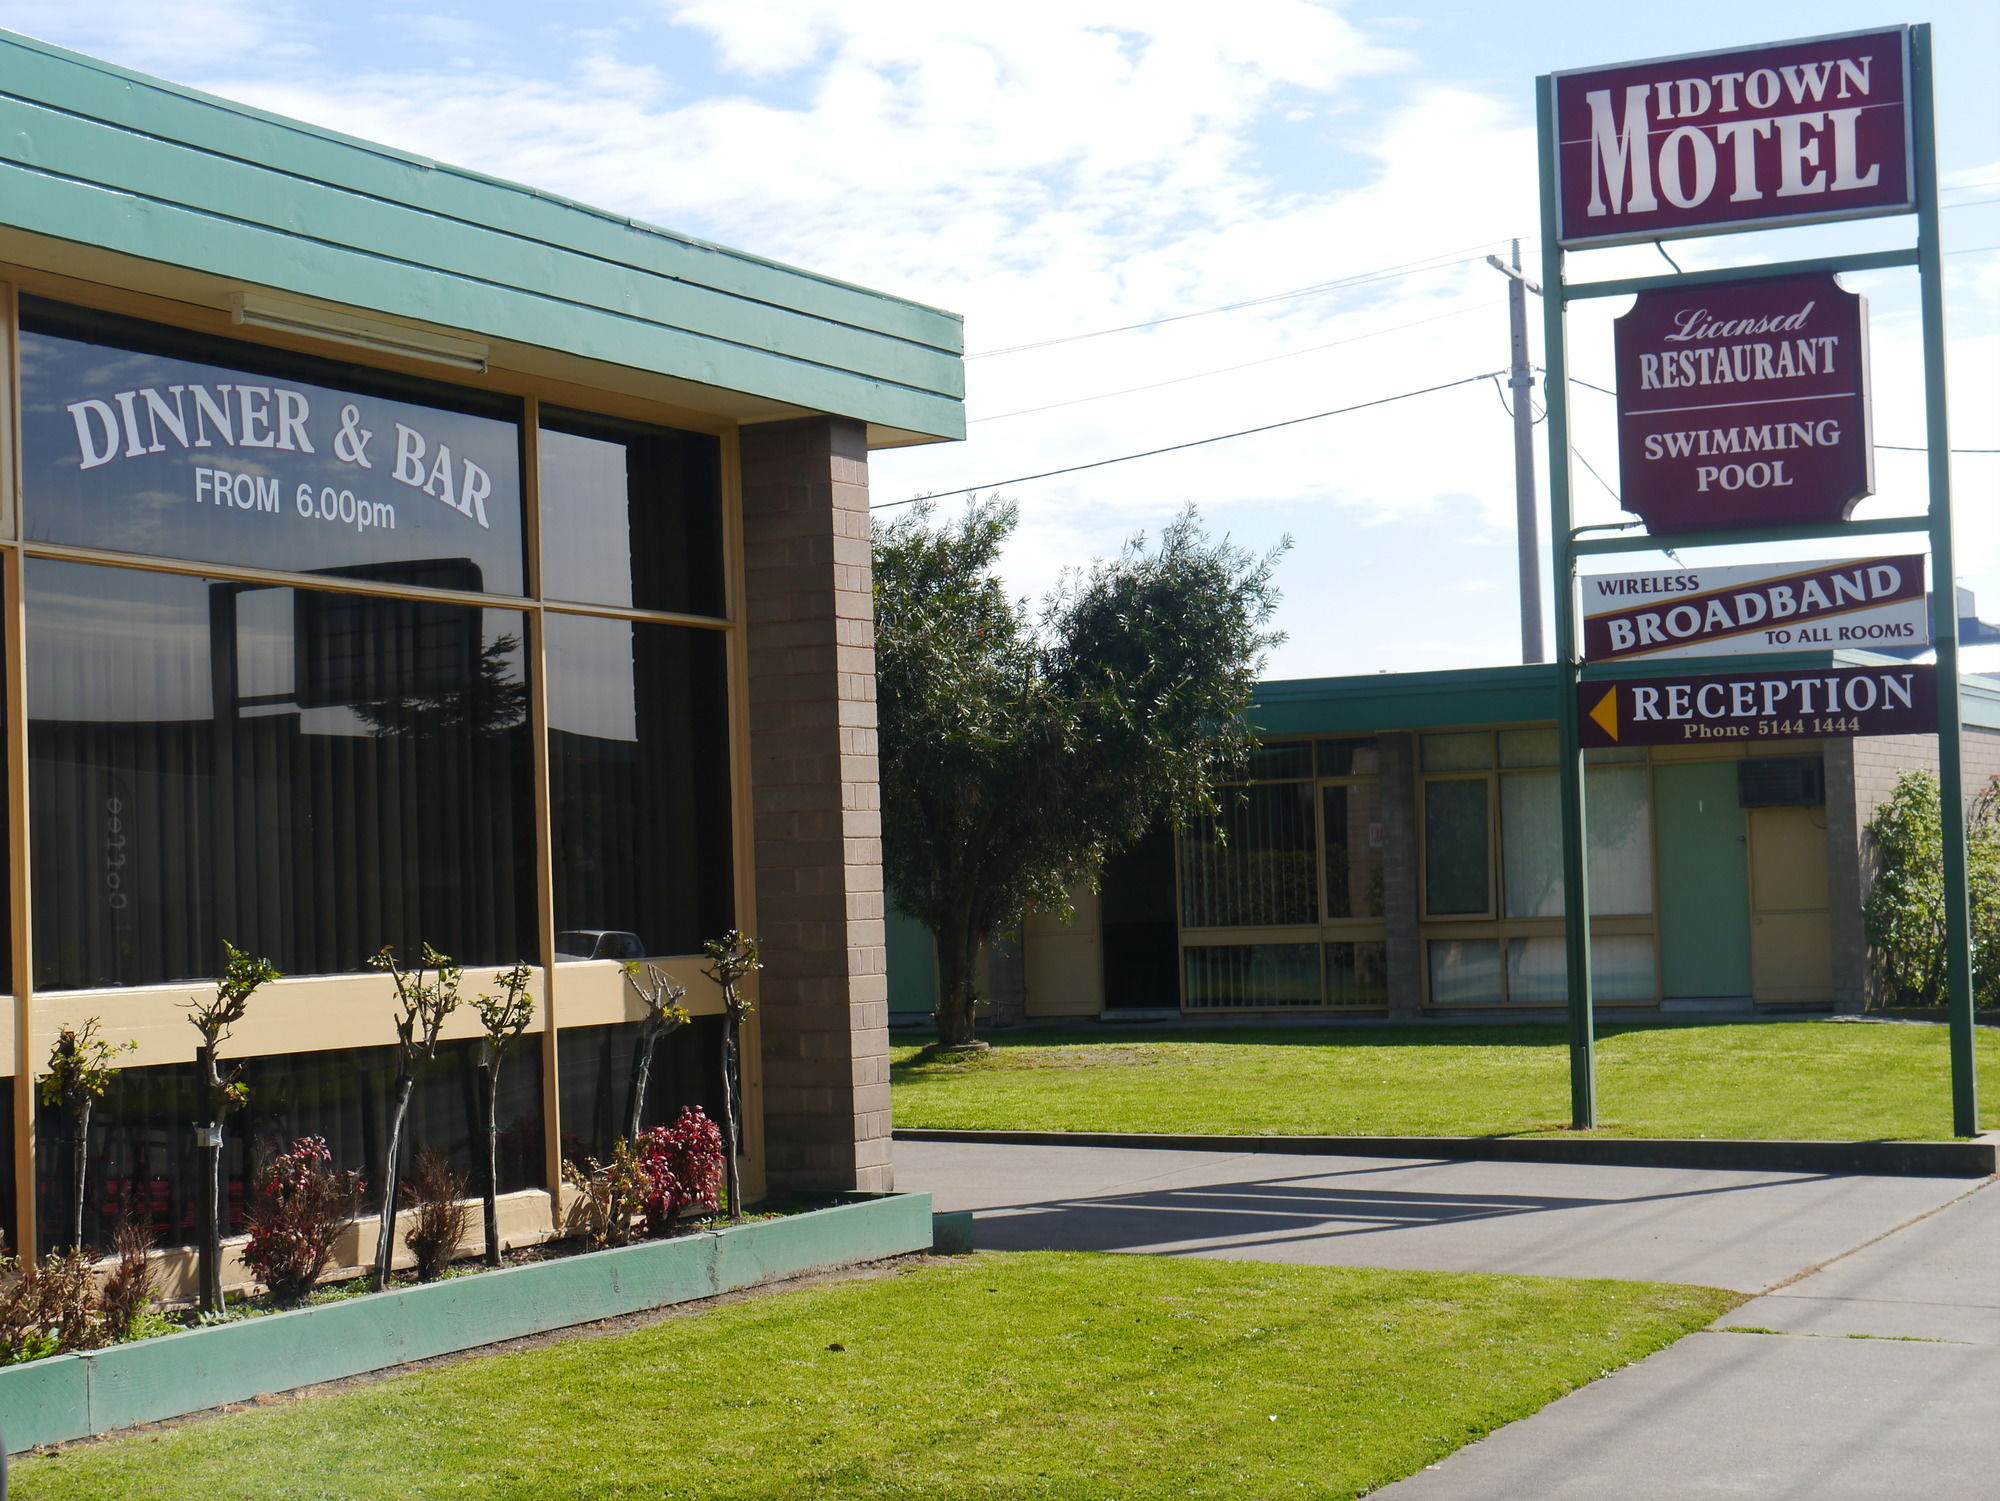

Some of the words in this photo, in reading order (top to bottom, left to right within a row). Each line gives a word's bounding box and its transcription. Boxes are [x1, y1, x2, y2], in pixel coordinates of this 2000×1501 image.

[1586, 83, 1880, 217] MOTEL
[1664, 301, 1816, 342] Licensed
[1640, 336, 1838, 390] RESTAURANT
[66, 384, 315, 470] DINNER
[333, 404, 373, 469] &
[392, 422, 492, 529] BAR
[1645, 420, 1840, 460] SWIMMING
[1697, 461, 1793, 492] POOL
[195, 467, 280, 513] FROM
[296, 483, 395, 533] 6.00pm
[1597, 575, 1699, 596] WIRELESS
[1607, 565, 1901, 651] BROADBAND
[1765, 630, 1791, 645] TO
[1798, 628, 1832, 643] ALL
[1839, 622, 1914, 641] ROOMS
[1632, 674, 1914, 721] RECEPTION
[1683, 723, 1750, 739] Phone
[1758, 719, 1804, 735] 5144
[1813, 717, 1860, 733] 1444
